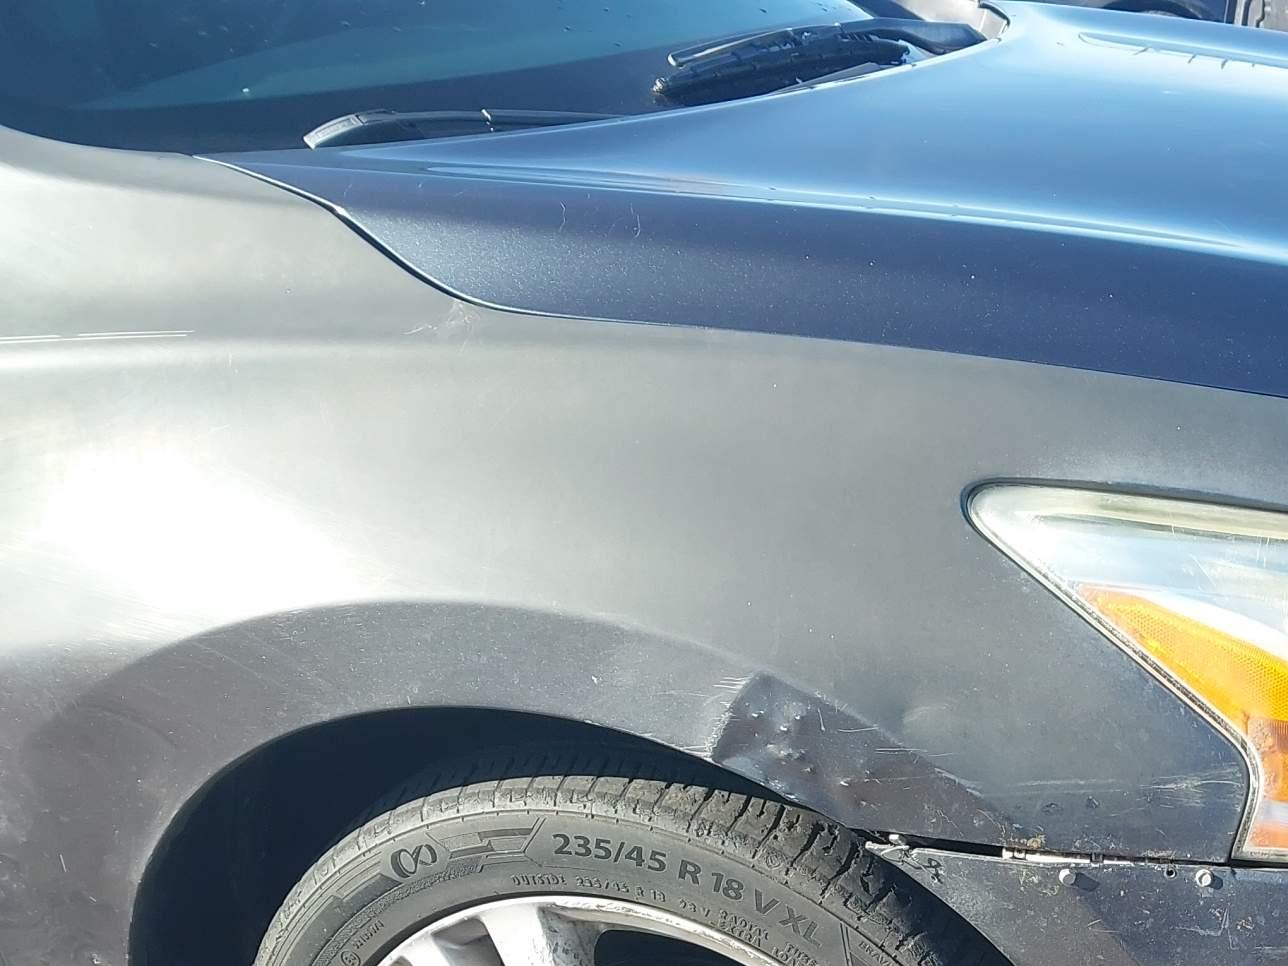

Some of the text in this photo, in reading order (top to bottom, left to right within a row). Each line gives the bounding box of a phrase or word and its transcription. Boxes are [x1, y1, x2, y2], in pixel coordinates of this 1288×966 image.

[552, 833, 823, 949] 235/45 R 18 V XL
